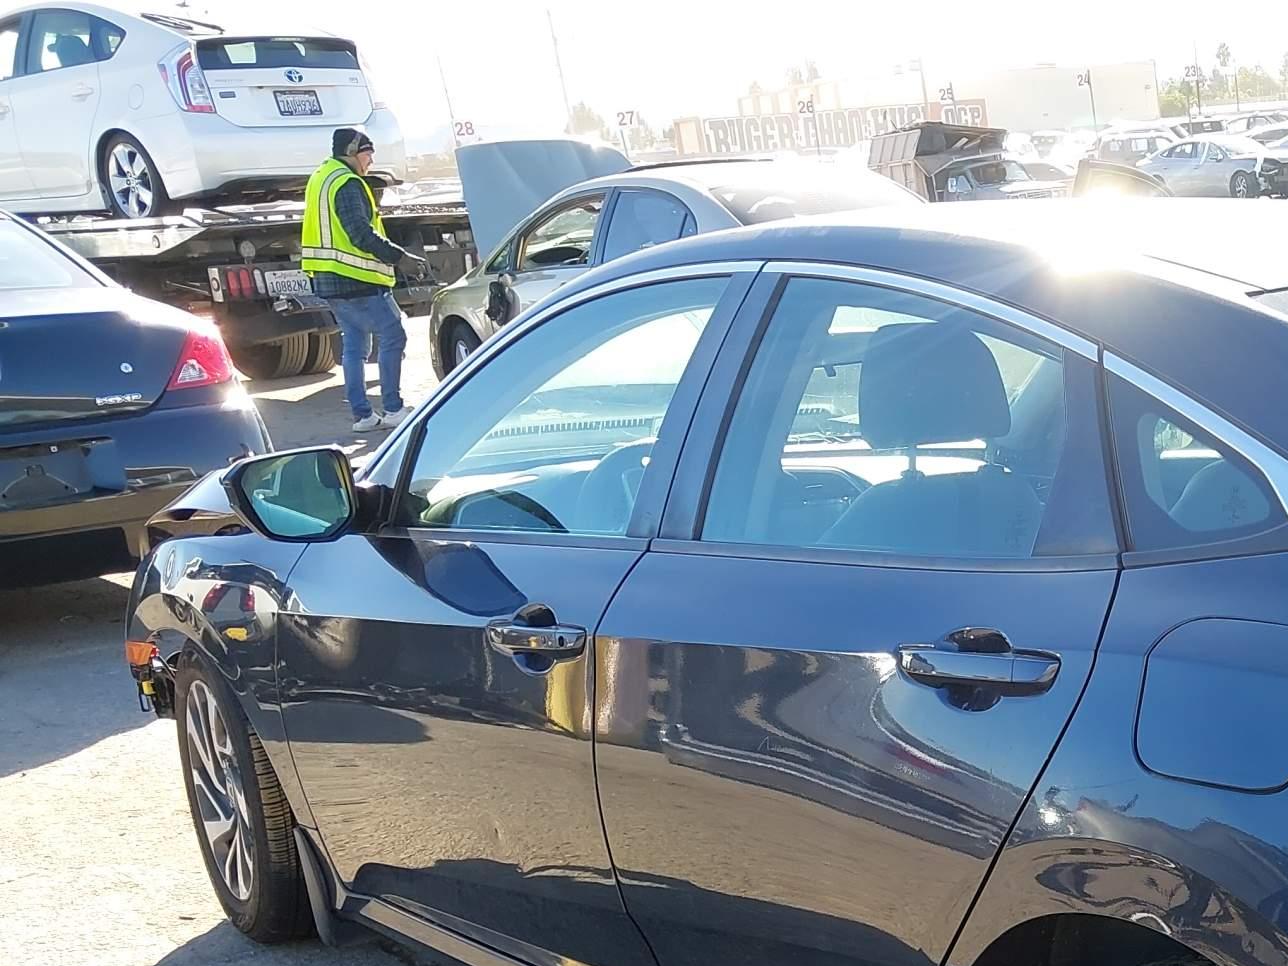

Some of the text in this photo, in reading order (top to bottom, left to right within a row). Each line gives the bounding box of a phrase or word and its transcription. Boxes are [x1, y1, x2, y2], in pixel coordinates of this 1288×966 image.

[1184, 66, 1196, 77] 23
[1077, 74, 1090, 86] 24
[938, 87, 953, 101] 25
[797, 100, 814, 114] 26
[616, 110, 634, 126] 27
[454, 121, 475, 137] 28
